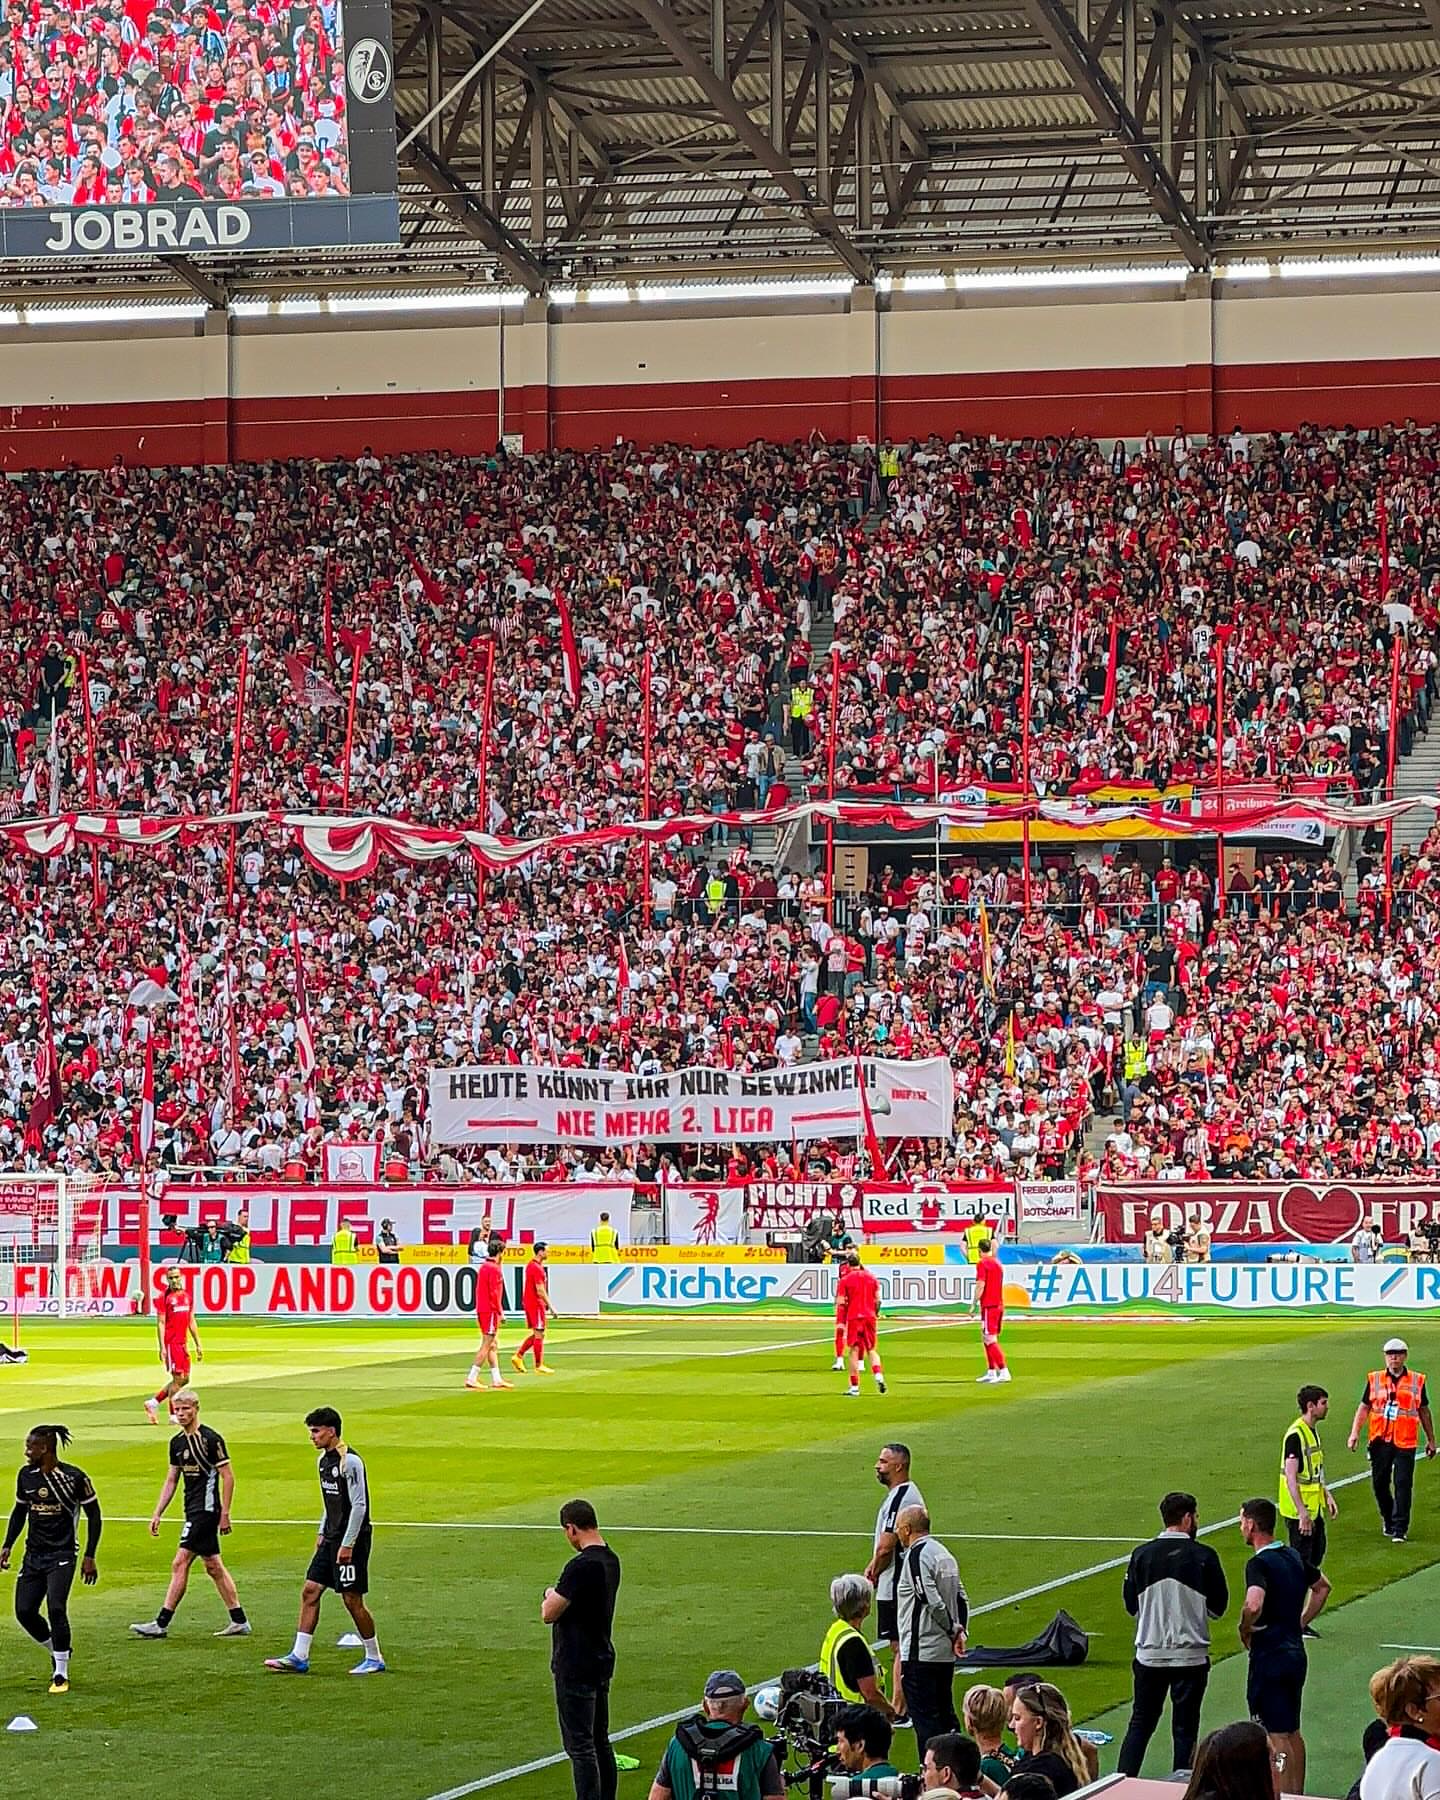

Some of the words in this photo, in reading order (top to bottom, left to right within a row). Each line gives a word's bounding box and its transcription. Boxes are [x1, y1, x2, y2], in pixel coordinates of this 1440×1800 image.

[45, 206, 251, 251] JOBRAD
[450, 1072, 528, 1099] HEUTE
[537, 1070, 614, 1101] KÖNNT
[626, 1078, 671, 1100] IHR
[680, 1070, 729, 1096] NUR
[557, 1110, 595, 1137] NIE
[605, 1109, 671, 1137] MEHR
[682, 1107, 703, 1133] 2.
[713, 1106, 774, 1133] LIGA
[1022, 1185, 1075, 1194] FREIBURGER
[869, 1199, 908, 1216] Red
[954, 1198, 1010, 1216] Label
[1024, 1206, 1075, 1217] BOTSCHAFT
[625, 1247, 658, 1257] LOTTO
[758, 1247, 787, 1257] LOTT
[894, 1247, 928, 1257] LOTTO
[268, 1266, 355, 1312] AND
[642, 1266, 778, 1299] Richter
[1028, 1264, 1354, 1303] #ALU4FUTURE
[339, 1564, 356, 1582] 20
